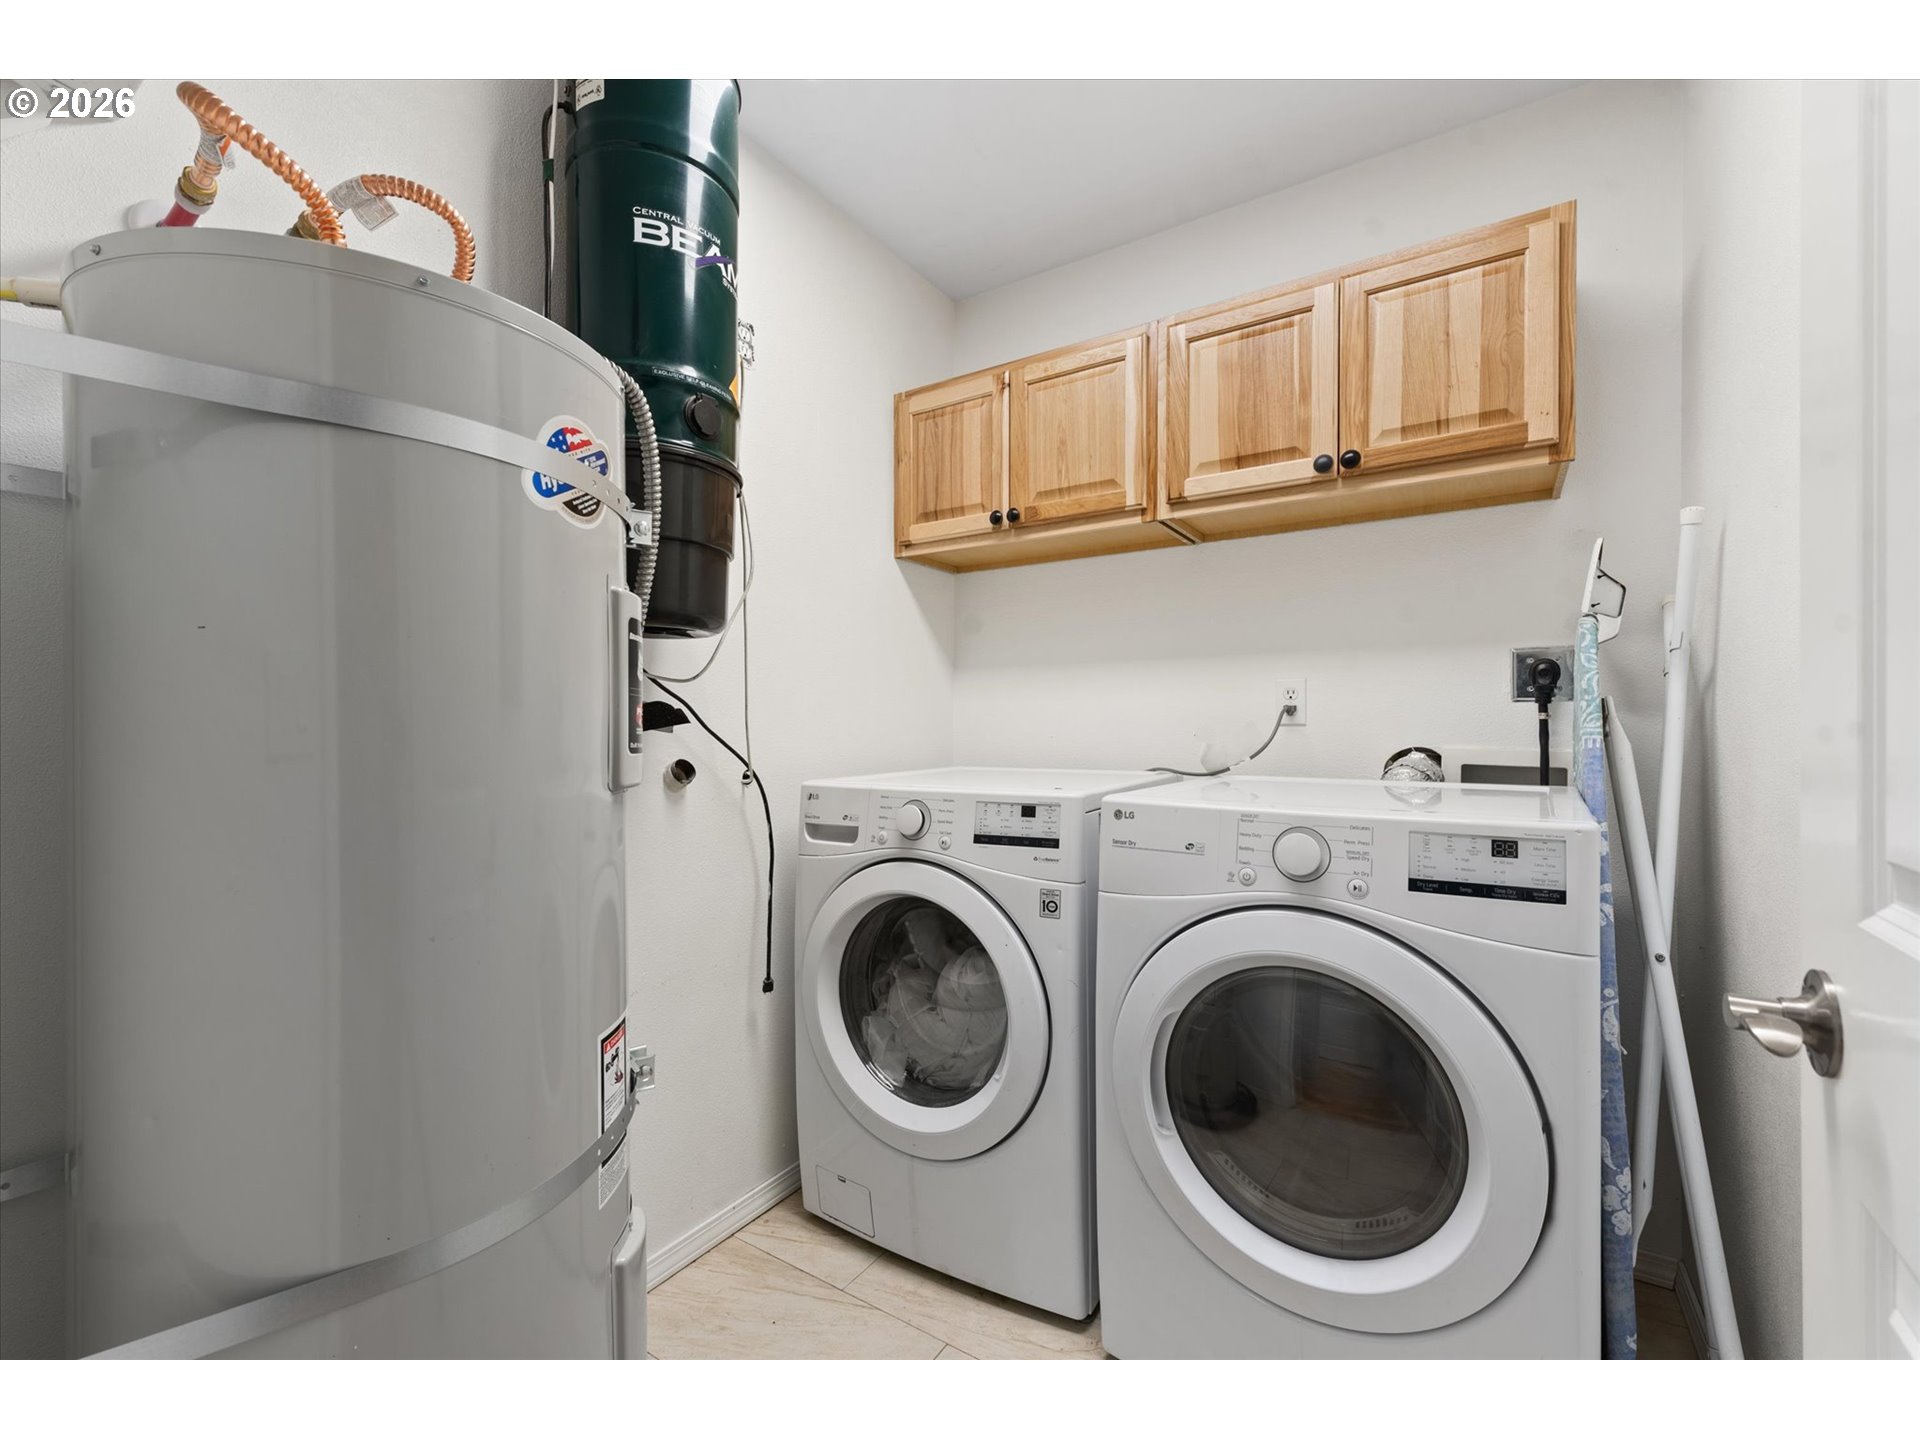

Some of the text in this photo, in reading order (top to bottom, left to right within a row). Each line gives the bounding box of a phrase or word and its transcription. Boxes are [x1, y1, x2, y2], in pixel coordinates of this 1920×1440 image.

[632, 206, 721, 246] CENTRAL VACUUM
[1124, 811, 1135, 819] LG
